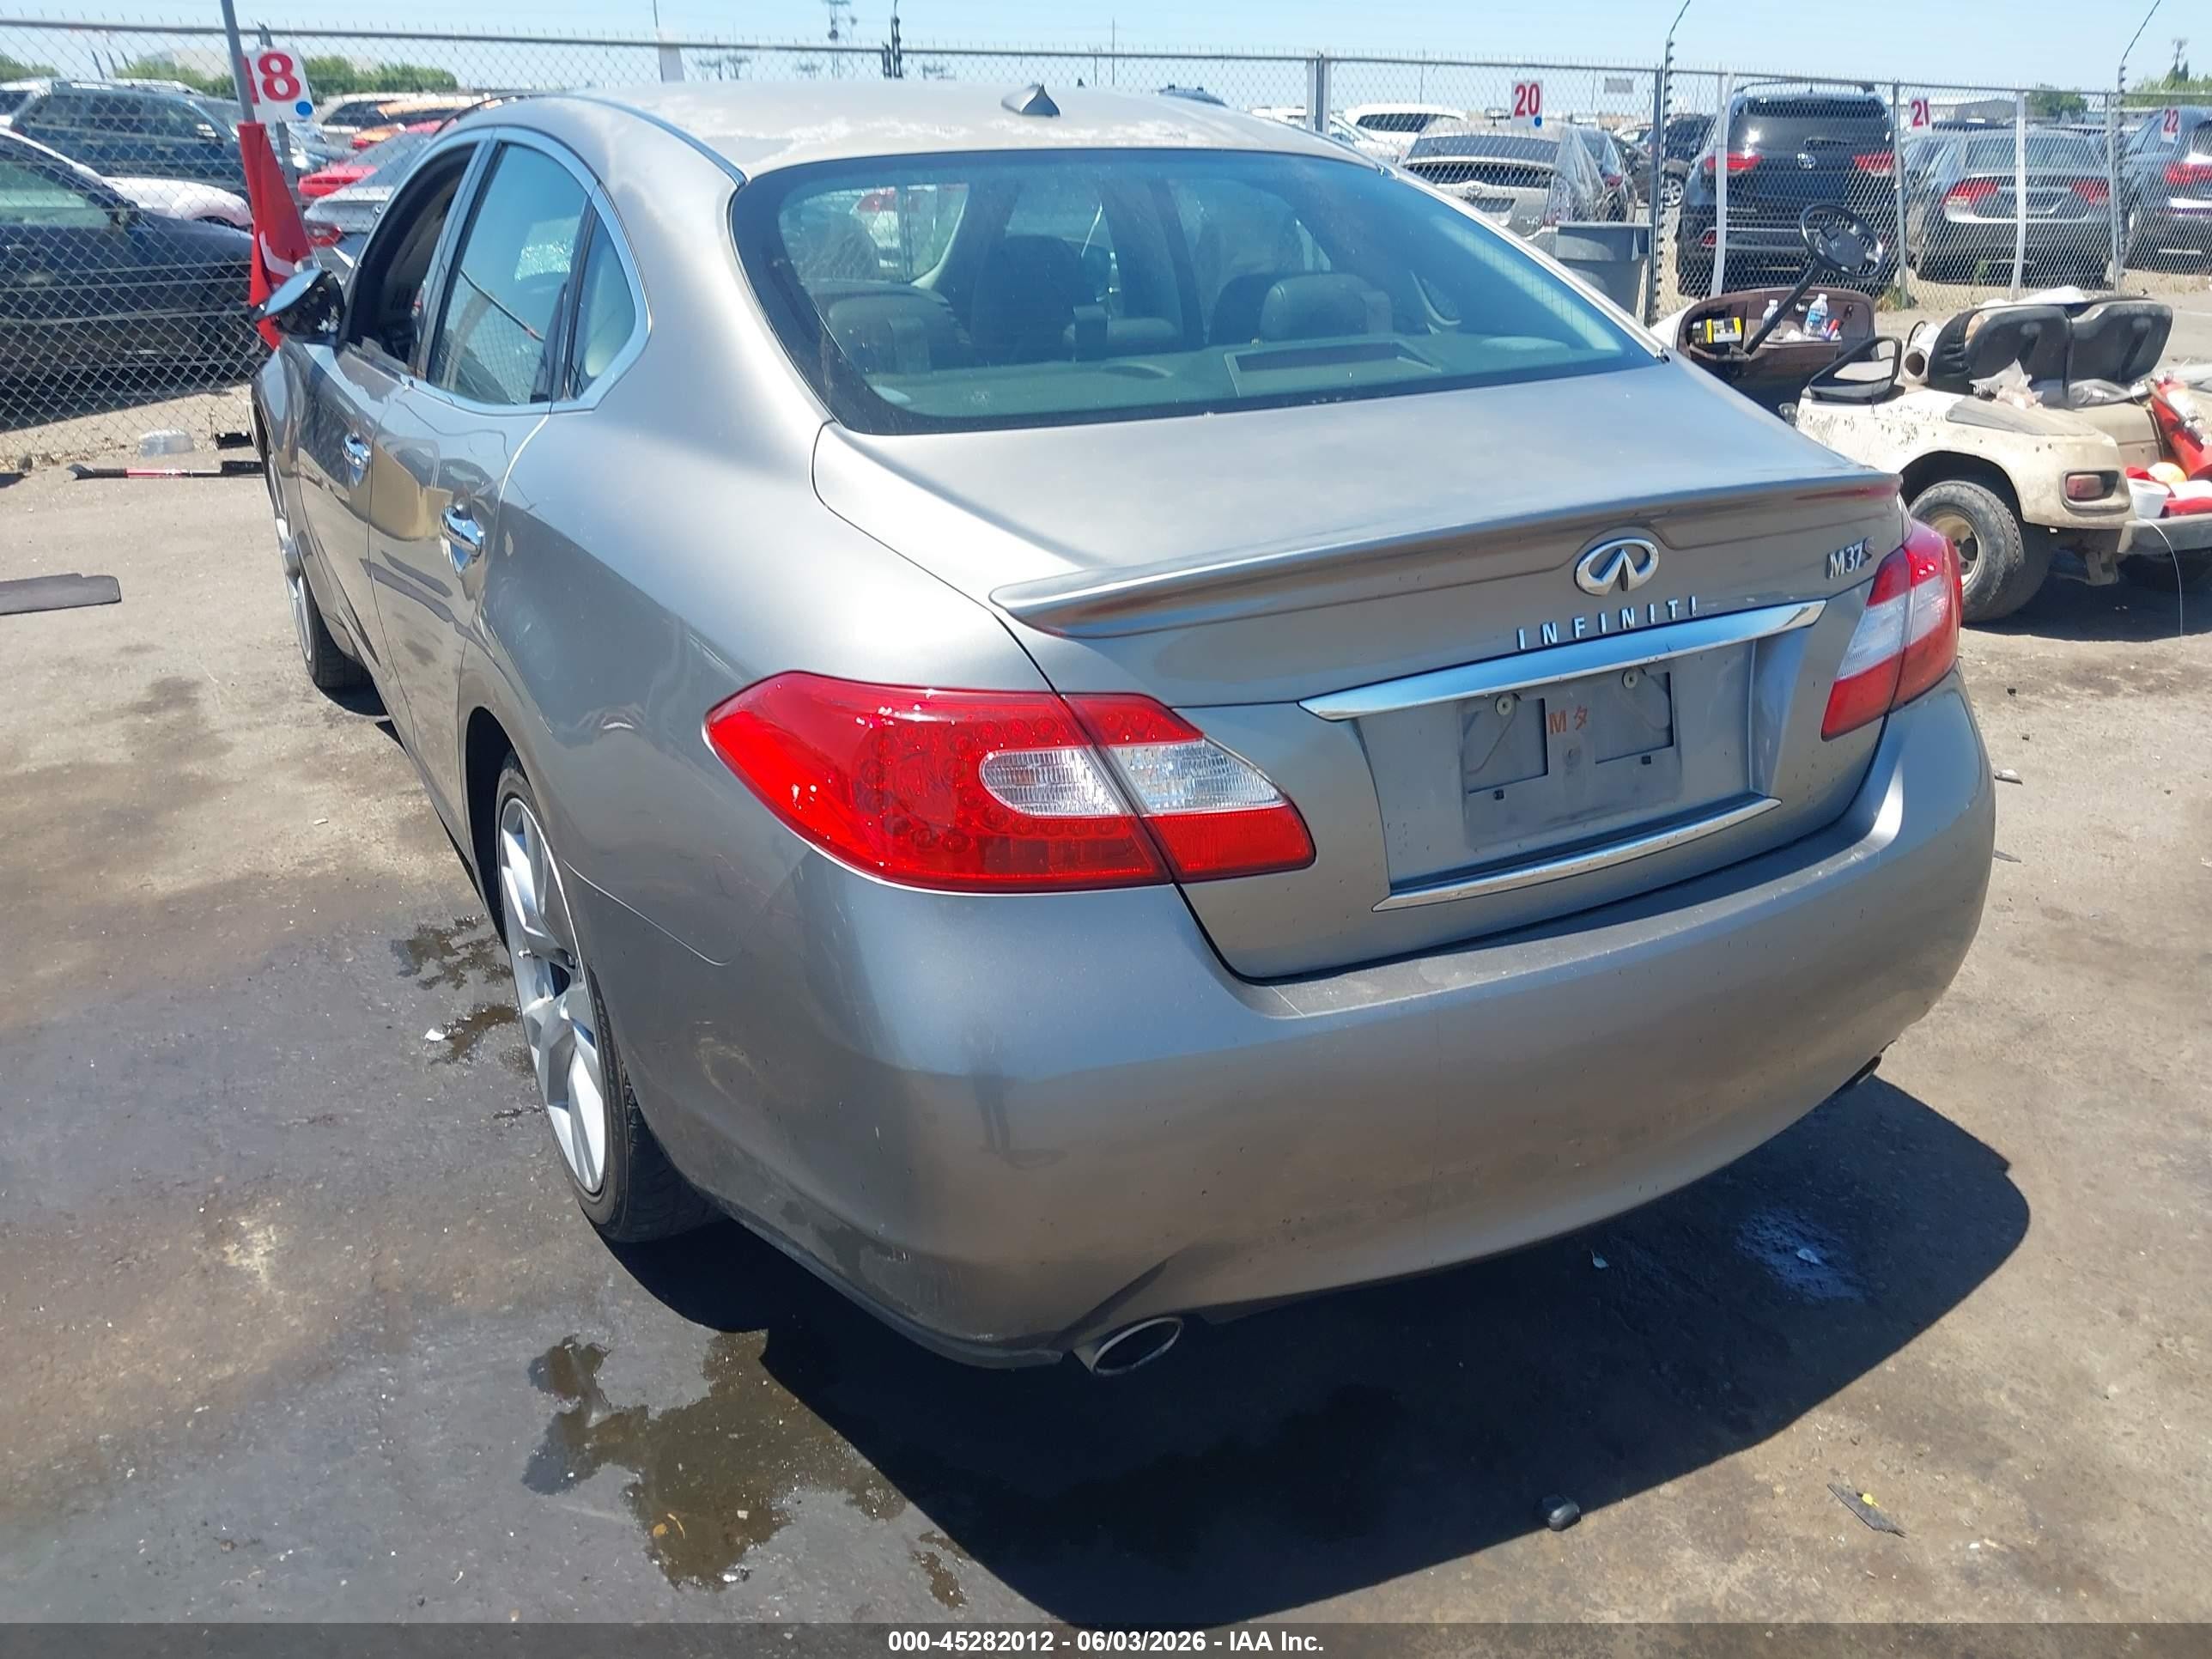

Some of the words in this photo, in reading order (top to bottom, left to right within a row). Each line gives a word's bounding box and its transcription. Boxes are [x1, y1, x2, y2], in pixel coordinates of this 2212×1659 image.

[1514, 83, 1540, 117] 20
[1911, 99, 1929, 127] 21
[2164, 109, 2179, 132] 22
[1516, 596, 1698, 650] INFINITI
